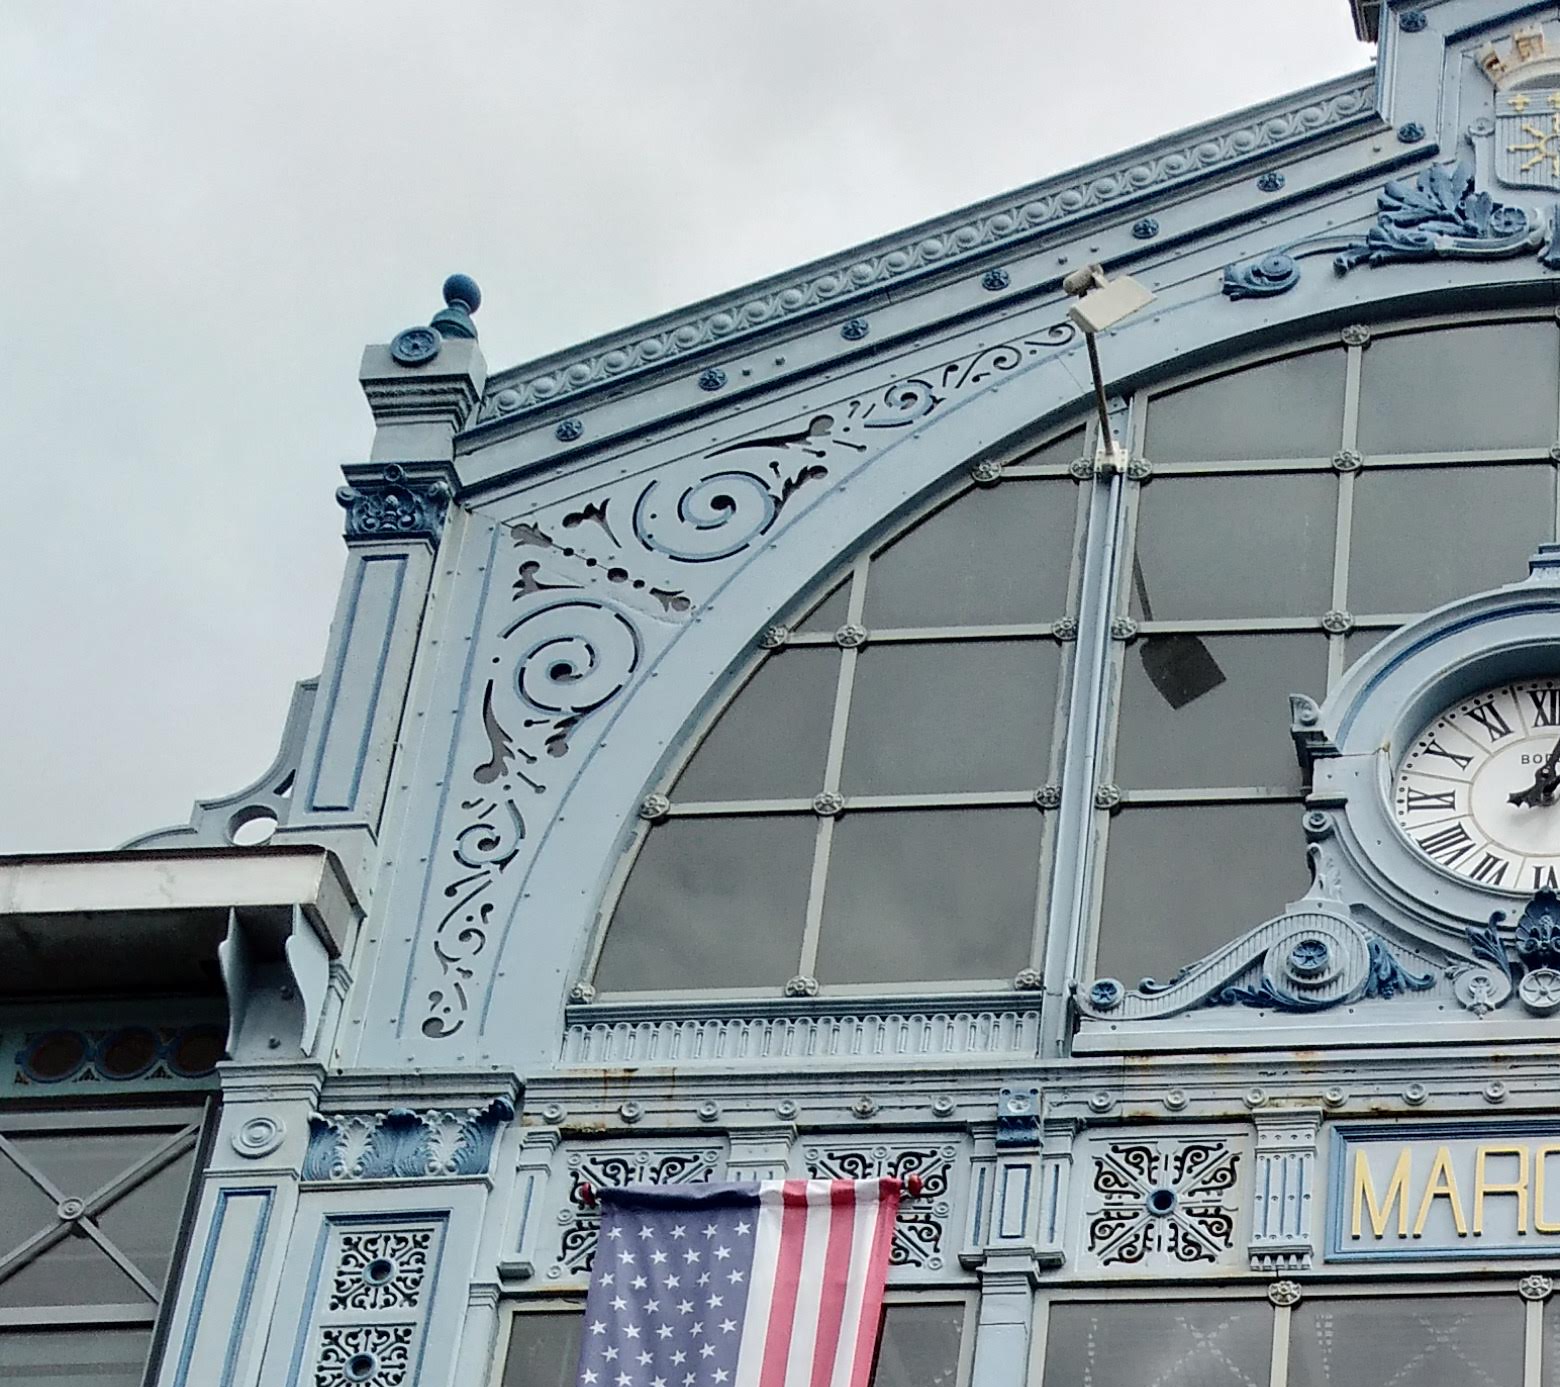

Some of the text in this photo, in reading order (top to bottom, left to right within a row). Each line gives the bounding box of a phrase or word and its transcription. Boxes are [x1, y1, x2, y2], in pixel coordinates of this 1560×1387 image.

[1464, 701, 1514, 742] XI
[1422, 739, 1474, 771] X
[1407, 787, 1456, 814] IX
